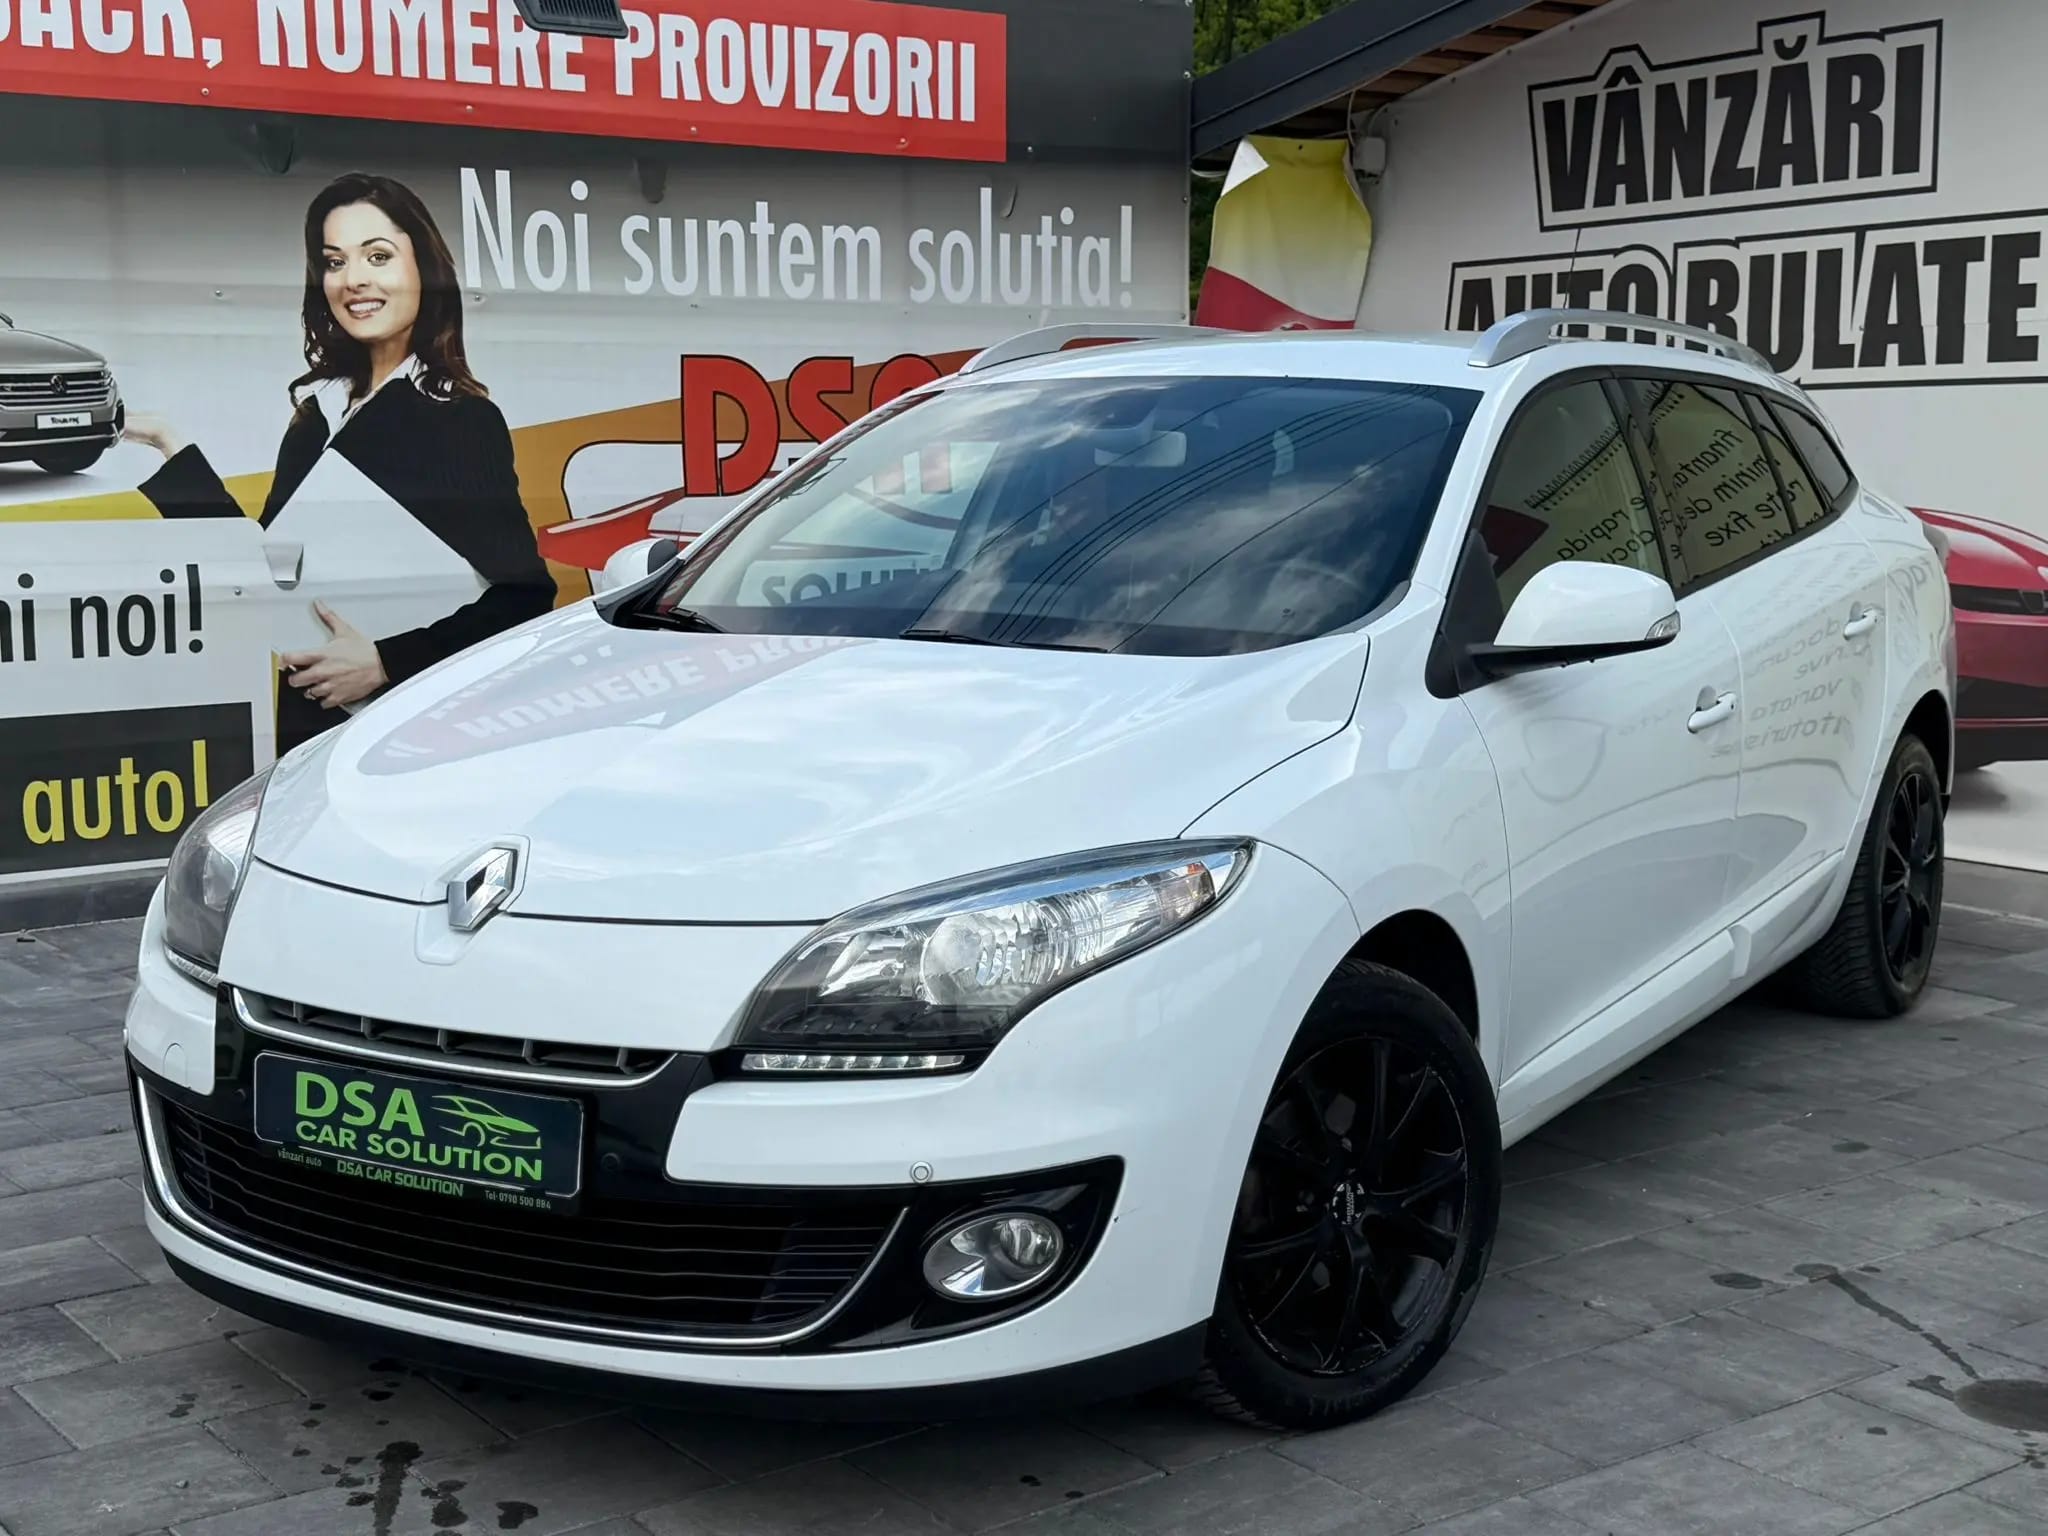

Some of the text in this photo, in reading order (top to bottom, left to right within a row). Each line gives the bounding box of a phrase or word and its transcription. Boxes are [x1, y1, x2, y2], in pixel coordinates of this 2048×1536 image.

[257, 0, 587, 92] NUMERE
[614, 10, 976, 122] PROVIZORII
[1541, 34, 1926, 212] VÂNZĂRI
[460, 167, 1134, 308] Noi suntem solutia!
[69, 563, 204, 659] noi!
[295, 1070, 425, 1137] DSA
[295, 1120, 542, 1181] CAR SOLUTION
[336, 1159, 464, 1197] DSA CAR SOLUTION
